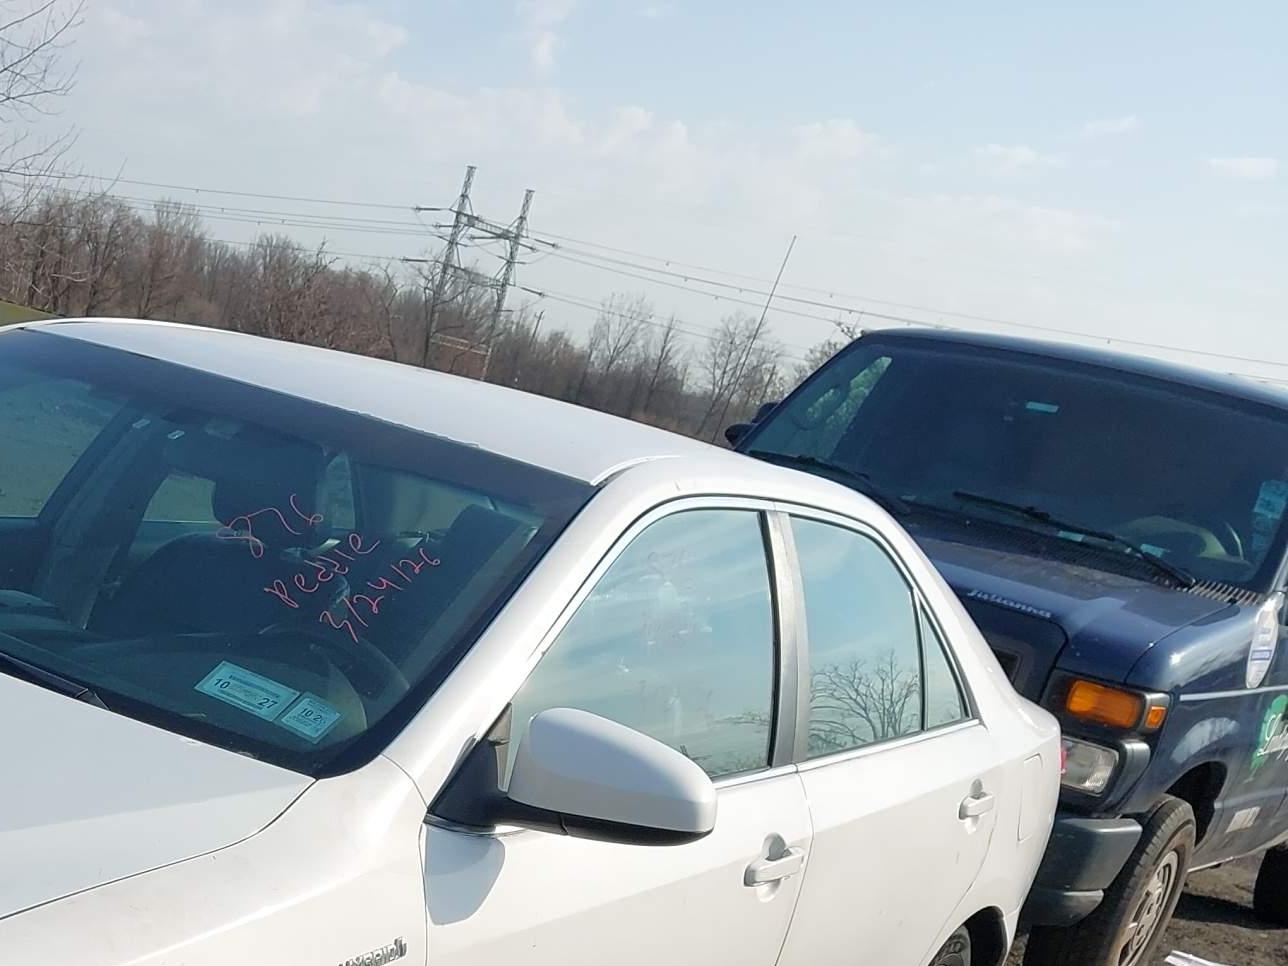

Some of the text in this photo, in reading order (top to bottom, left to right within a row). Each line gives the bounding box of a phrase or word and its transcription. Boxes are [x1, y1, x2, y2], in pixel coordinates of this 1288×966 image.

[215, 493, 324, 558] 876
[318, 547, 441, 643] 3/24/26
[214, 679, 229, 690] 10
[261, 698, 278, 709] 27
[300, 707, 314, 718] 10
